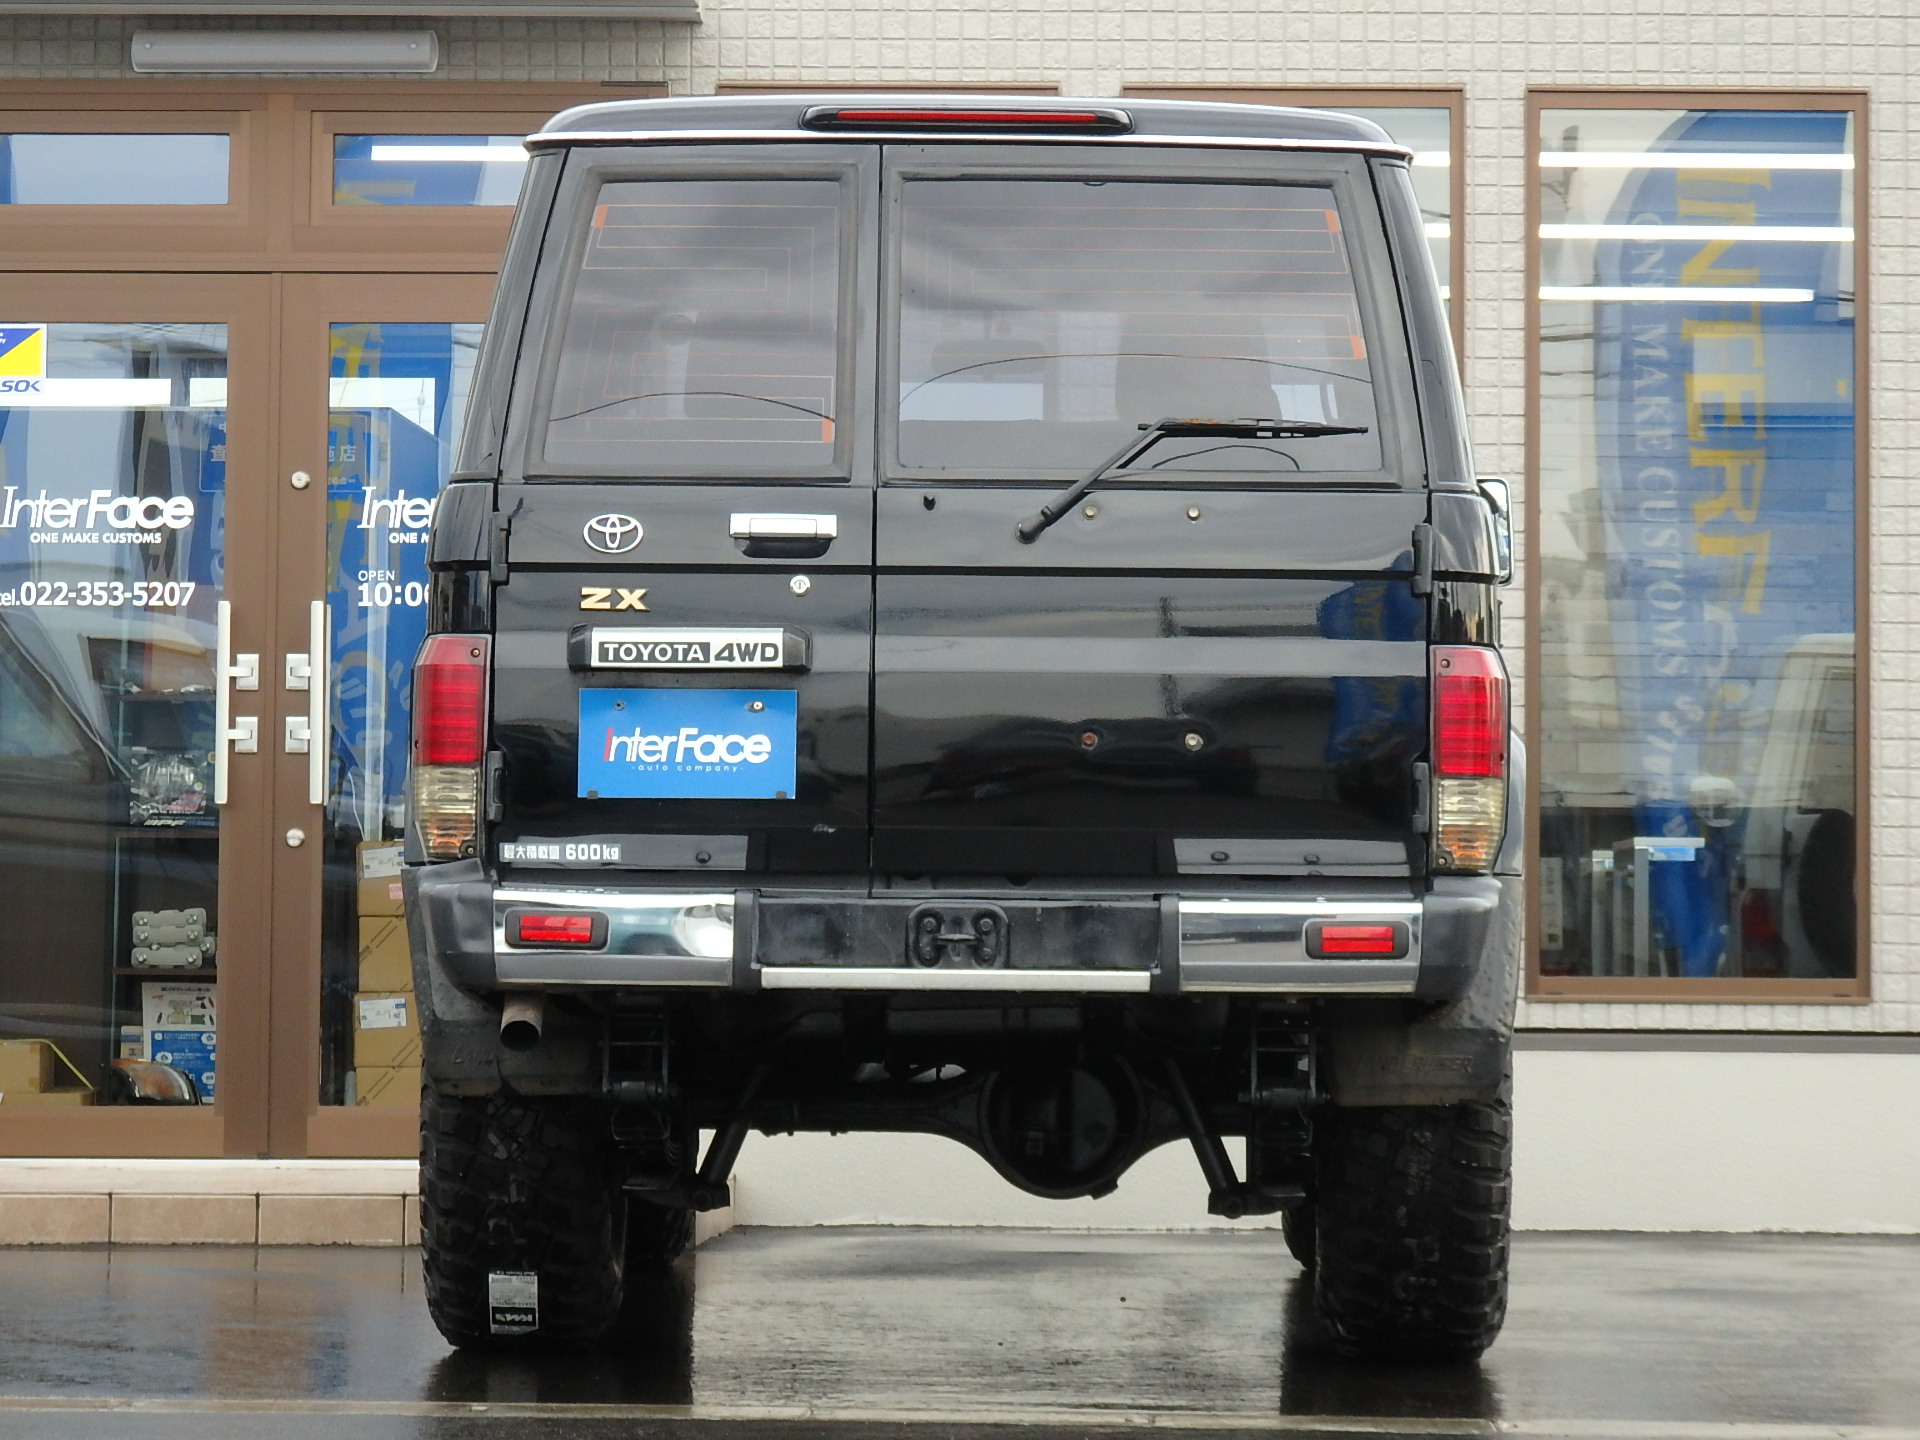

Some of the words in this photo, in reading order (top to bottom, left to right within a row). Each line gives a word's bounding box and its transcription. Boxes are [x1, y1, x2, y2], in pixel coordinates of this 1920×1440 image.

[1632, 324, 1677, 452] MAKE
[0, 485, 195, 529] InterFace
[30, 532, 59, 544] ONE
[62, 532, 99, 544] MAKE
[102, 532, 162, 544] CUSTOMS
[388, 532, 418, 544] ONE
[357, 570, 396, 582] OPEN
[1638, 466, 1690, 678] CUSTOMS
[357, 581, 430, 607] 10:0
[579, 586, 650, 612] ZX
[603, 643, 705, 662] TOYOTA
[714, 642, 779, 662] 4WD
[603, 726, 772, 764] InterFace
